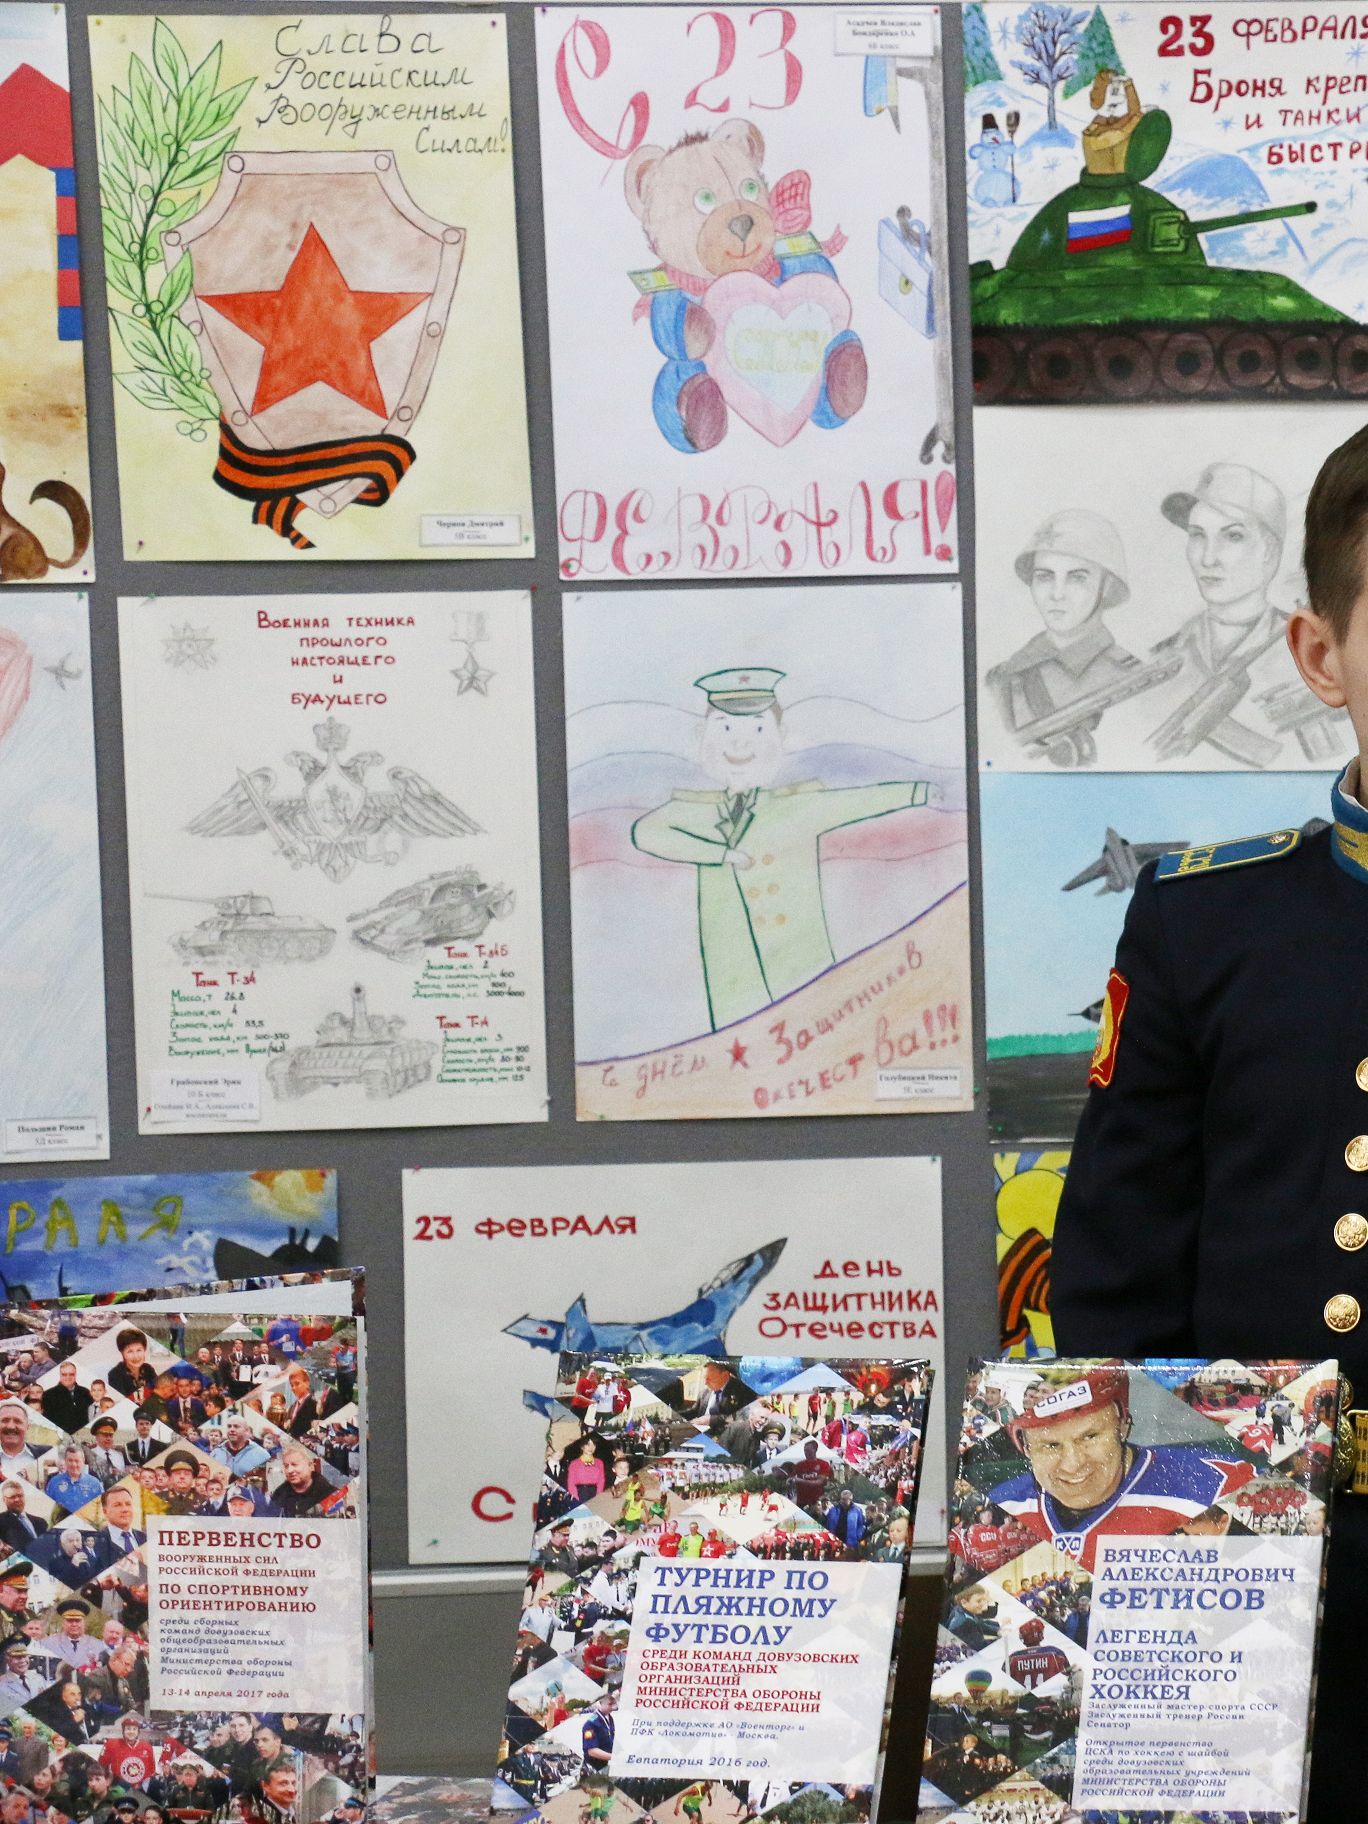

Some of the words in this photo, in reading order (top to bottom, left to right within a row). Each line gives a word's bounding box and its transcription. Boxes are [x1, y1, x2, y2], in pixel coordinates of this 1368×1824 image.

[275, 15, 445, 58] Слава
[1157, 15, 1215, 57] 23
[684, 8, 802, 113] 23
[264, 57, 473, 92] Российским
[256, 93, 487, 138] Вооруженным
[415, 119, 507, 155] Силам!
[412, 1215, 455, 1241] 23
[470, 1485, 516, 1524] С
[158, 1530, 322, 1549] ПЕРВЕНСТВО
[158, 1554, 251, 1564] ВООРУЖЕННЫХ
[255, 1556, 279, 1564] СИЛ
[1103, 1549, 1218, 1564] ВЯЧЕСЛАВ
[158, 1566, 238, 1577] РОССИЙСКОЙ
[242, 1568, 316, 1578] ФЕДЕРАЦИИ
[654, 1566, 776, 1589] ТУРНИР
[784, 1570, 829, 1590] ПО
[1101, 1567, 1296, 1584] АЛЕКСАНДРОВИЧ
[159, 1584, 181, 1594] ПО
[187, 1584, 309, 1597] СПОРТИВНОМУ
[159, 1600, 316, 1613] ОРИЕНТИРОВАНИЮ
[649, 1594, 838, 1618] ПЛЯЖНОМУ
[1099, 1587, 1265, 1611] ФЕТИСОВ
[159, 1618, 190, 1627] среди
[194, 1617, 239, 1626] сборных
[160, 1627, 200, 1636] команд
[204, 1628, 271, 1637] довузовских
[645, 1622, 792, 1646] ФУТБОЛУ
[1094, 1629, 1198, 1645] ЛЕГЕНДА
[160, 1646, 229, 1656] организаций
[642, 1649, 688, 1660] СРЕДИ
[693, 1650, 752, 1662] КОМАНД
[757, 1652, 859, 1665] ДОВУЗОВСКИХ
[1093, 1649, 1223, 1664] СОВЕТСКОГО
[1231, 1651, 1243, 1664] И
[160, 1657, 243, 1667] Министерства
[247, 1658, 293, 1667] обороны
[640, 1661, 778, 1674] ОБРАЗОВАТЕЛЬНЫХ
[1017, 1657, 1048, 1671] ПУТИН
[160, 1667, 222, 1677] Российской
[226, 1669, 285, 1678] Федерации
[638, 1673, 740, 1686] ОРГАНИЗАЦИЙ
[1092, 1665, 1237, 1682] РОССИЙСКОГО
[161, 1688, 190, 1696] 13-14
[194, 1690, 232, 1698] апреля
[236, 1690, 263, 1698] 2017
[266, 1691, 289, 1699] года
[636, 1686, 747, 1698] МИНИСТЕРСТВА
[752, 1689, 821, 1700] ОБОРОНЫ
[1089, 1684, 1191, 1700] ХОККЕЯ
[634, 1699, 729, 1711] РОССИЙСКОЙ
[734, 1702, 820, 1714] ФЕДЕРАЦИИ
[1250, 1703, 1278, 1711] СССР
[626, 1754, 704, 1768] Евпатория
[709, 1756, 742, 1767] 2016
[746, 1758, 770, 1768] год.
